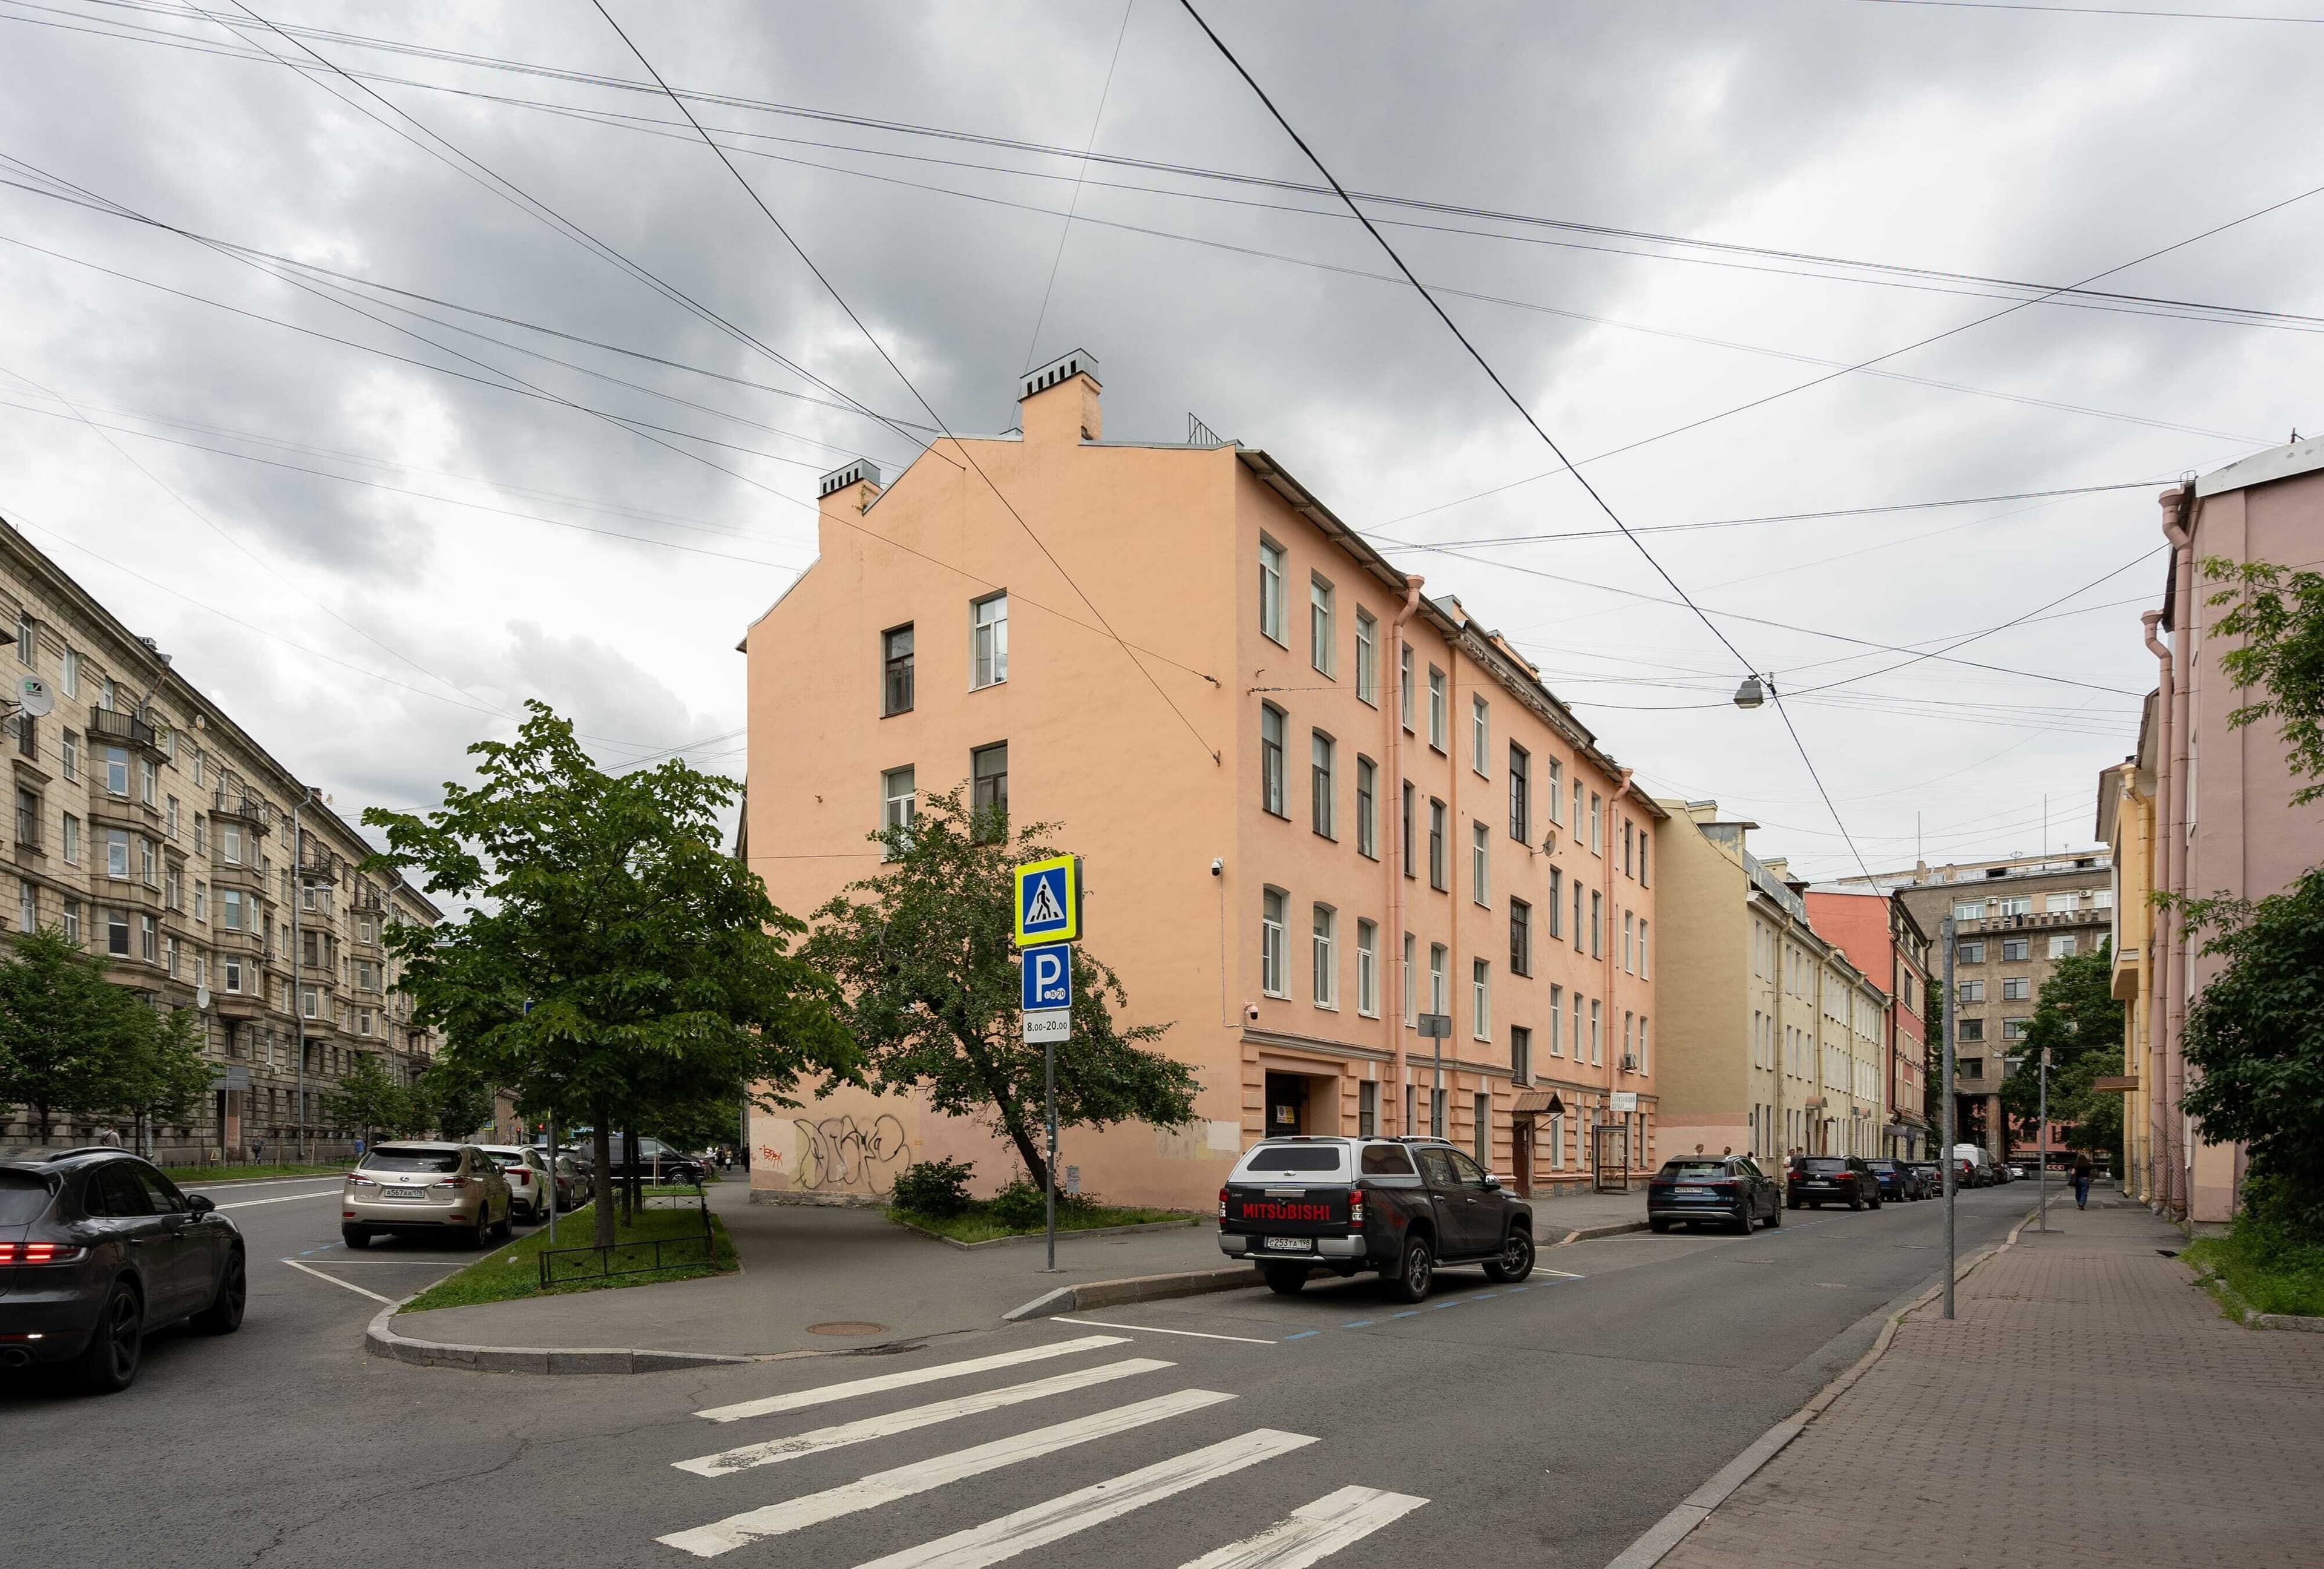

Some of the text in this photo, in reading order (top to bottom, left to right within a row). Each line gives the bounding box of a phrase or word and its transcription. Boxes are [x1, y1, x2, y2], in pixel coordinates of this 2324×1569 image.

[1036, 954, 1061, 1002] P
[1027, 1021, 1068, 1031] 8.00-20.00
[1242, 1203, 1330, 1220] MITSUBISHI
[1269, 1238, 1298, 1247] С253ТА
